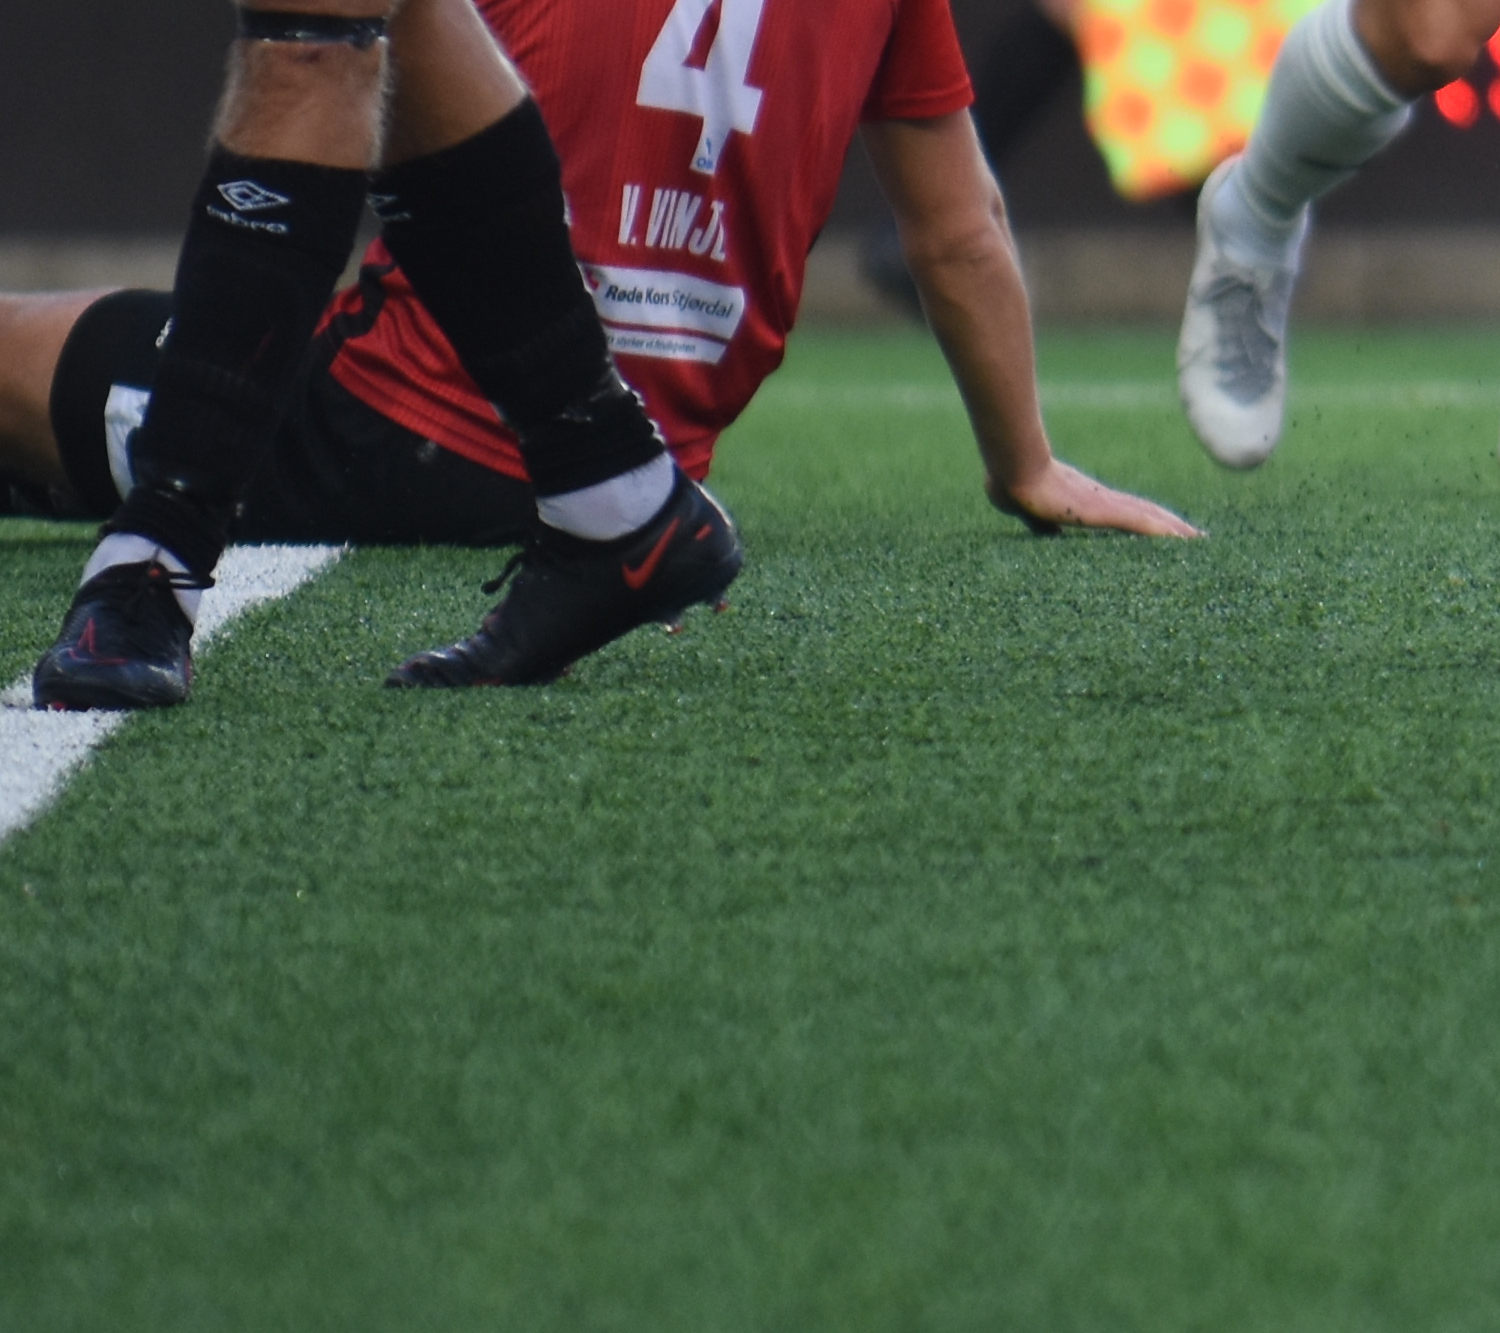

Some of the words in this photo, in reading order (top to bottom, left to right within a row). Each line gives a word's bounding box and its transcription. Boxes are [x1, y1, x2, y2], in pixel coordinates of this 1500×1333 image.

[618, 184, 641, 246] V.
[605, 284, 643, 305] Røde
[644, 287, 670, 306] Kors
[671, 289, 734, 320] Stjørdal
